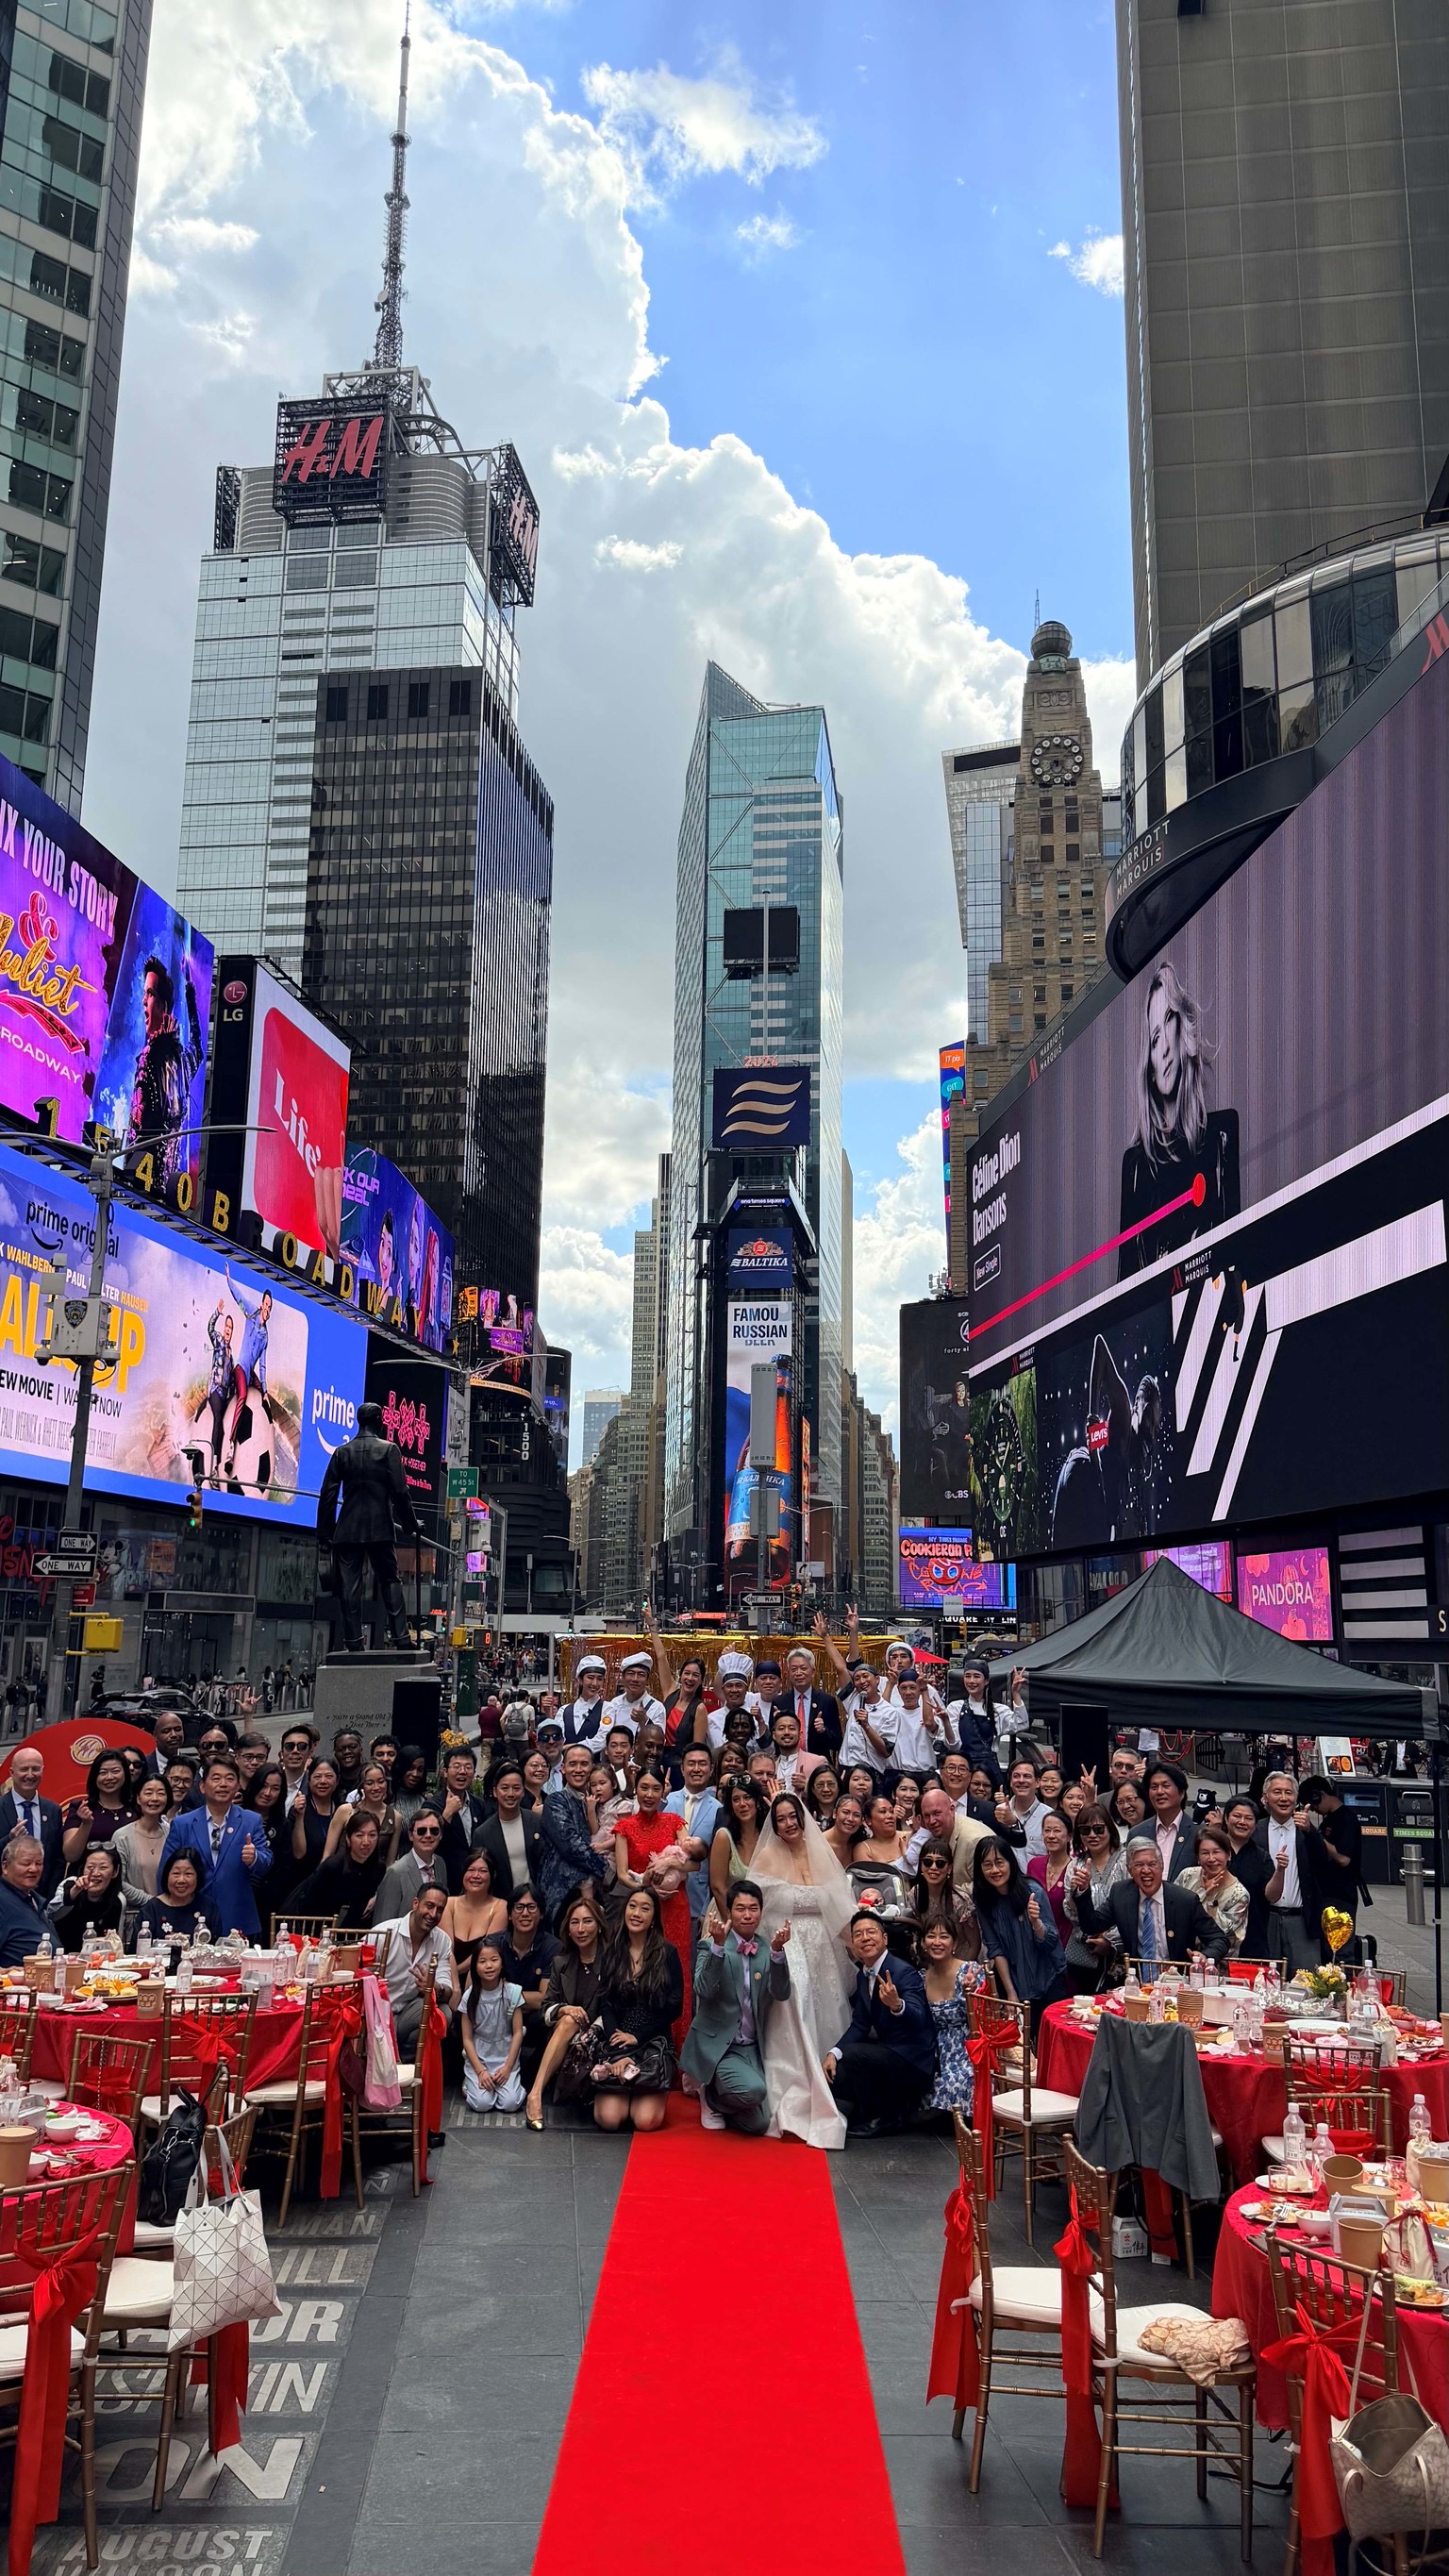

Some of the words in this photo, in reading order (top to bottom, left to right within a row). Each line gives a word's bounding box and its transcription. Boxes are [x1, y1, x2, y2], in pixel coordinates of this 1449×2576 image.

[282, 415, 385, 483] H&M
[1115, 819, 1171, 880] MARRIOTT
[24, 817, 66, 898] YOUR
[68, 860, 119, 939] STORY
[1115, 846, 1163, 900] MARQUIS
[223, 1008, 244, 1022] LG
[0, 1025, 82, 1085] ROADWAY
[1040, 1025, 1065, 1058] MARRIOTT
[1040, 1043, 1063, 1073] MARQUIS
[342, 1165, 355, 1185] K
[357, 1171, 380, 1196] OUR
[972, 1152, 999, 1204] Céline
[999, 1130, 1022, 1179] Dion
[26, 1200, 69, 1235] prime
[71, 1221, 120, 1259] origal
[973, 1191, 1008, 1247] Dansons
[741, 1257, 789, 1267] BALTIKA
[975, 1261, 986, 1280] New
[985, 1254, 998, 1273] Single
[1184, 1250, 1213, 1272] MARRIOTT
[1185, 1264, 1209, 1284] MARQUIS
[66, 1268, 87, 1290] PAUL
[89, 1278, 119, 1301] LTER
[733, 1307, 779, 1322] FAMOU
[732, 1324, 788, 1339] RUSSIAN
[944, 1347, 960, 1355] forty
[1019, 1346, 1036, 1361] MARRIOTT
[1019, 1356, 1034, 1368] MARQUIS
[19, 1374, 55, 1401] MOVIE
[99, 1397, 123, 1419] NOW
[311, 1385, 356, 1430] prime
[521, 1422, 530, 1461] 1500
[63, 1538, 76, 1547] ONE
[80, 1539, 92, 1548] WAY
[900, 1539, 962, 1557] COOKIERUN
[42, 1561, 59, 1570] ONE
[67, 1562, 88, 1570] WAY
[1251, 1581, 1314, 1607] PANDORA
[1438, 1610, 1447, 1632] S
[1361, 1827, 1386, 1835] SQUARE
[1395, 1829, 1415, 1837] TIMES
[270, 2249, 355, 2284] ILL
[62, 2530, 274, 2562] AUGUST
